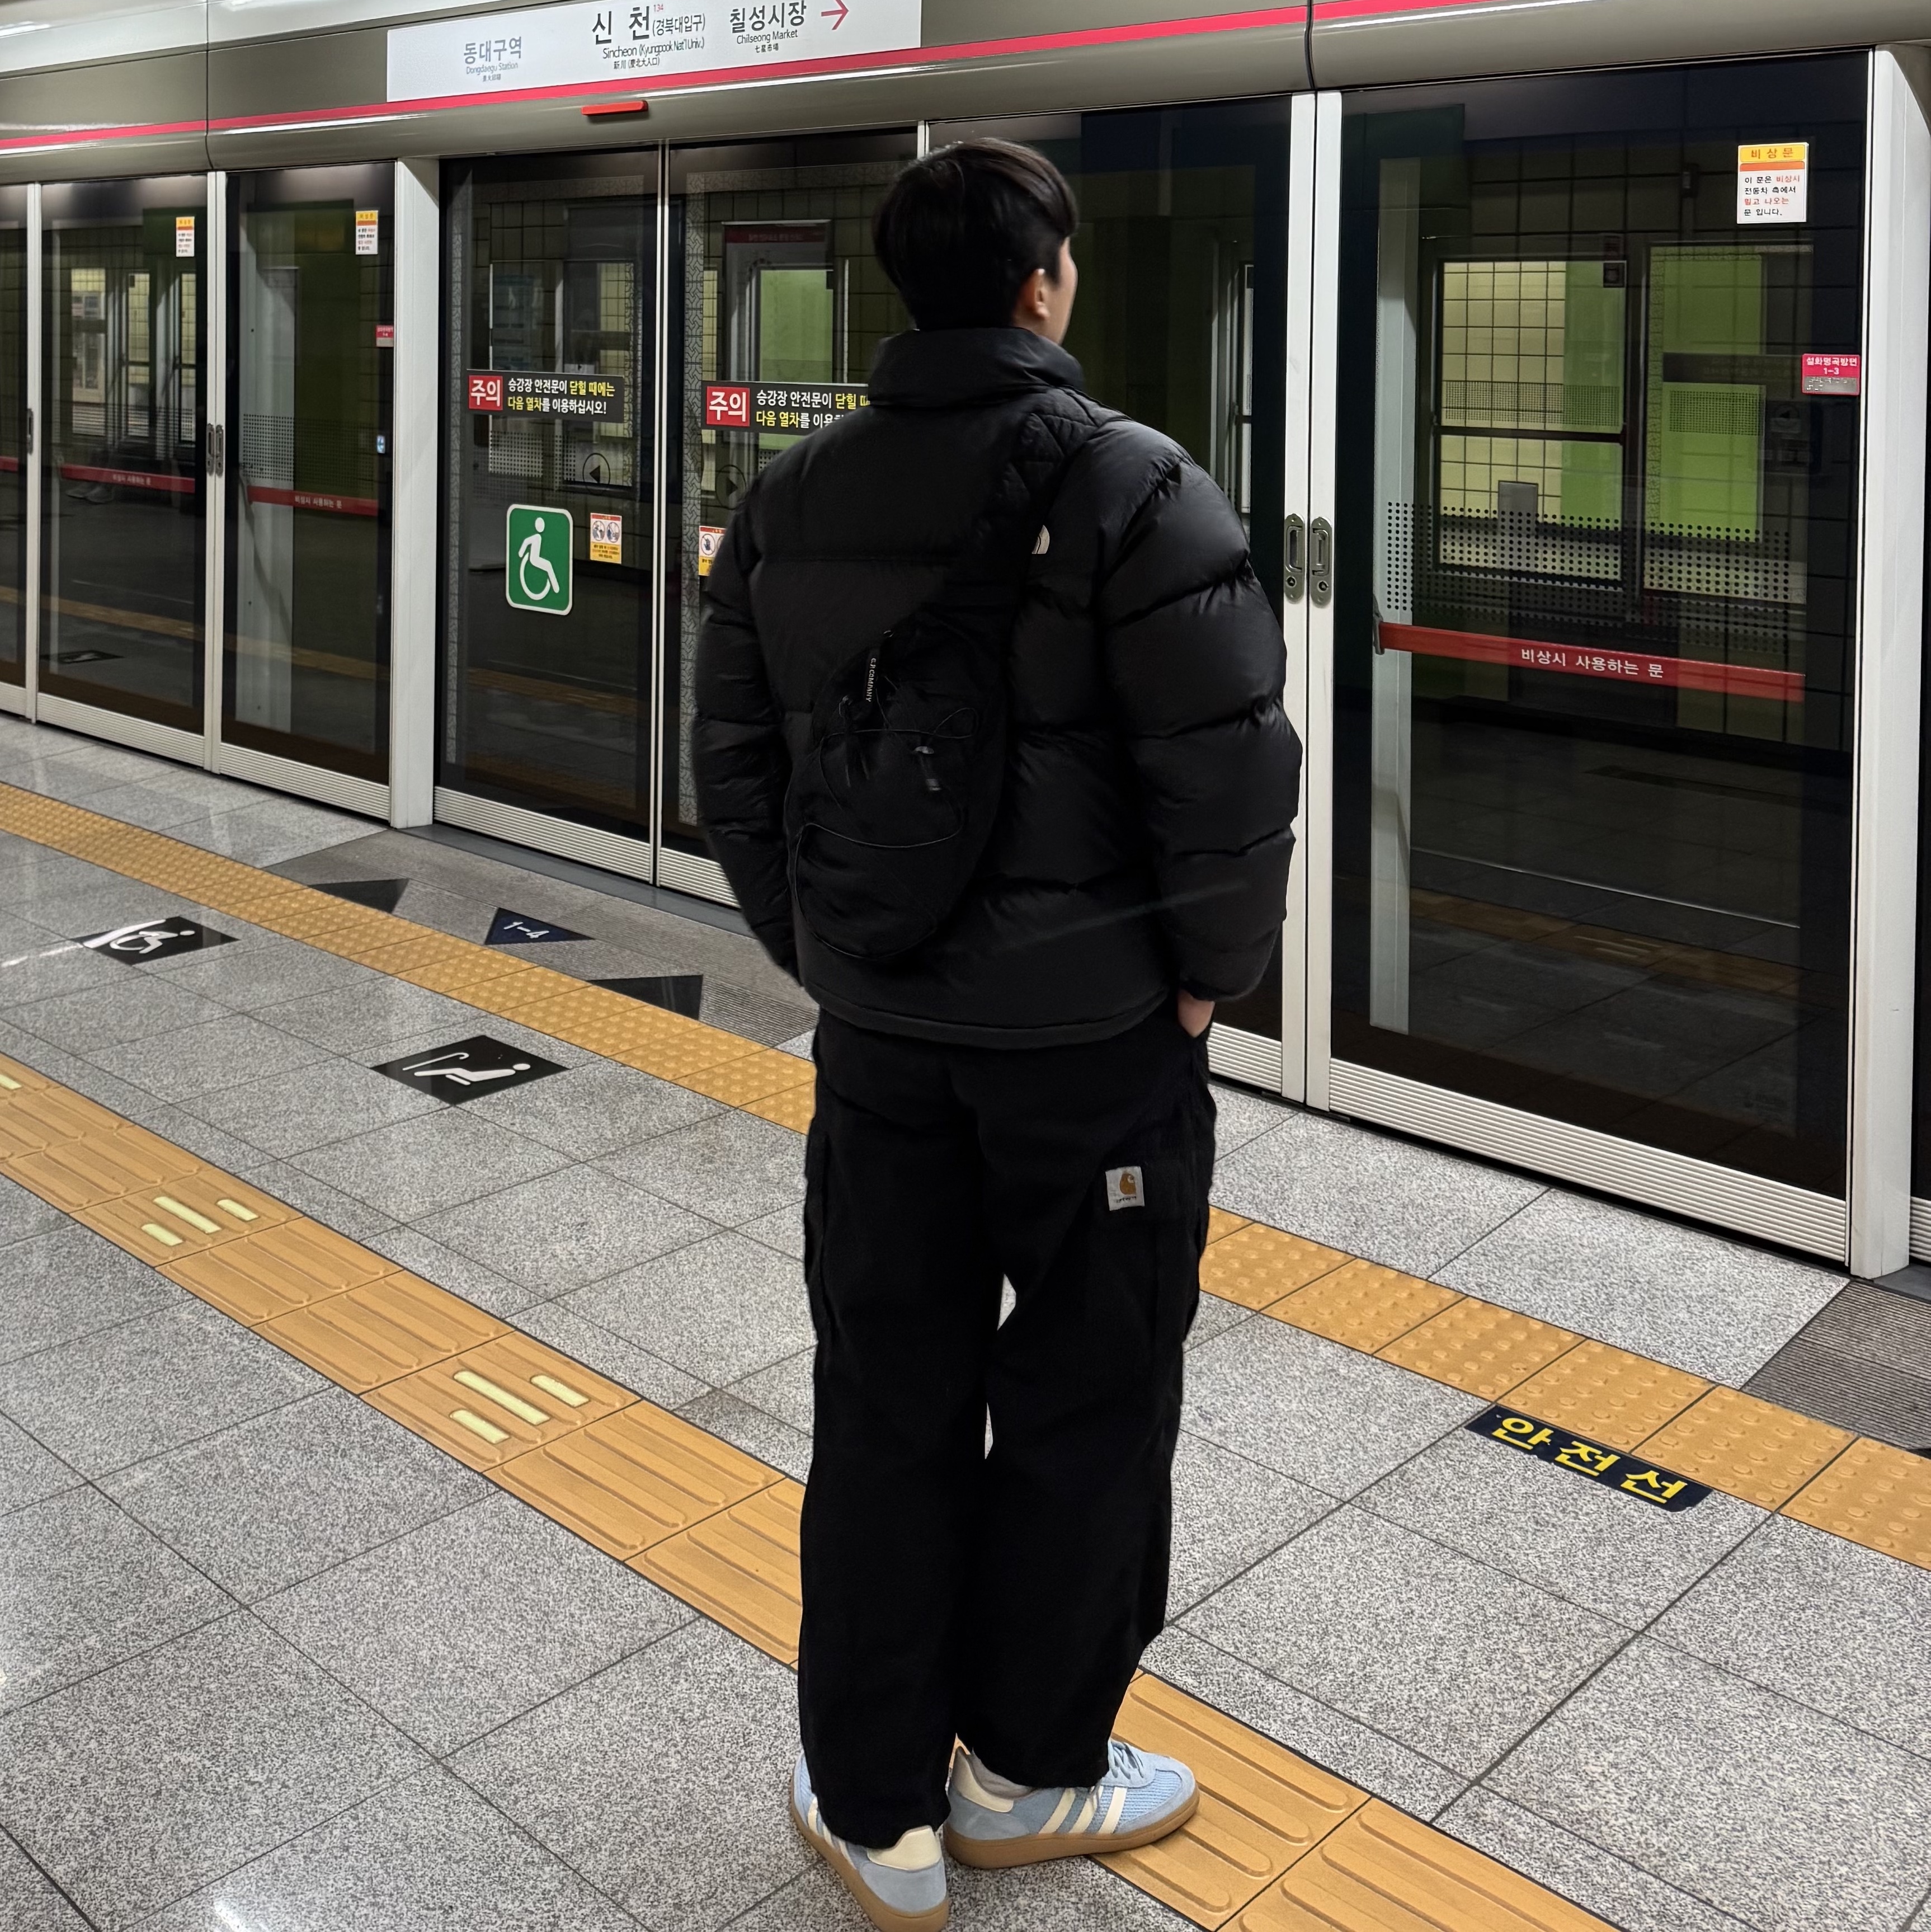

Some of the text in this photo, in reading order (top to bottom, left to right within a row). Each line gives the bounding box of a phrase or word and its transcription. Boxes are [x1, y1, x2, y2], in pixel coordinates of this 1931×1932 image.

[653, 4, 663, 12] 134
[729, 0, 807, 34] 칠성시장
[737, 29, 798, 44] Chilseong Market
[464, 36, 521, 64] 동대구역
[602, 45, 637, 59] Sincheon
[466, 62, 518, 76] Dongdaegu Station
[1751, 147, 1793, 159] 비상문
[470, 379, 501, 407] 주의
[508, 378, 615, 397] 승강장 안전문이 닫힐 때에는
[508, 396, 606, 415] 다음 열차를 이용하십시오!
[709, 391, 746, 422] 주의
[756, 389, 788, 406] 승강장
[790, 391, 832, 409] 안전문이
[835, 393, 856, 410] 닫힐
[756, 411, 776, 427] 다음
[779, 411, 811, 429] 열차를
[1521, 648, 1664, 678] 비상시 사용하는 문
[503, 922, 549, 939] 1-4
